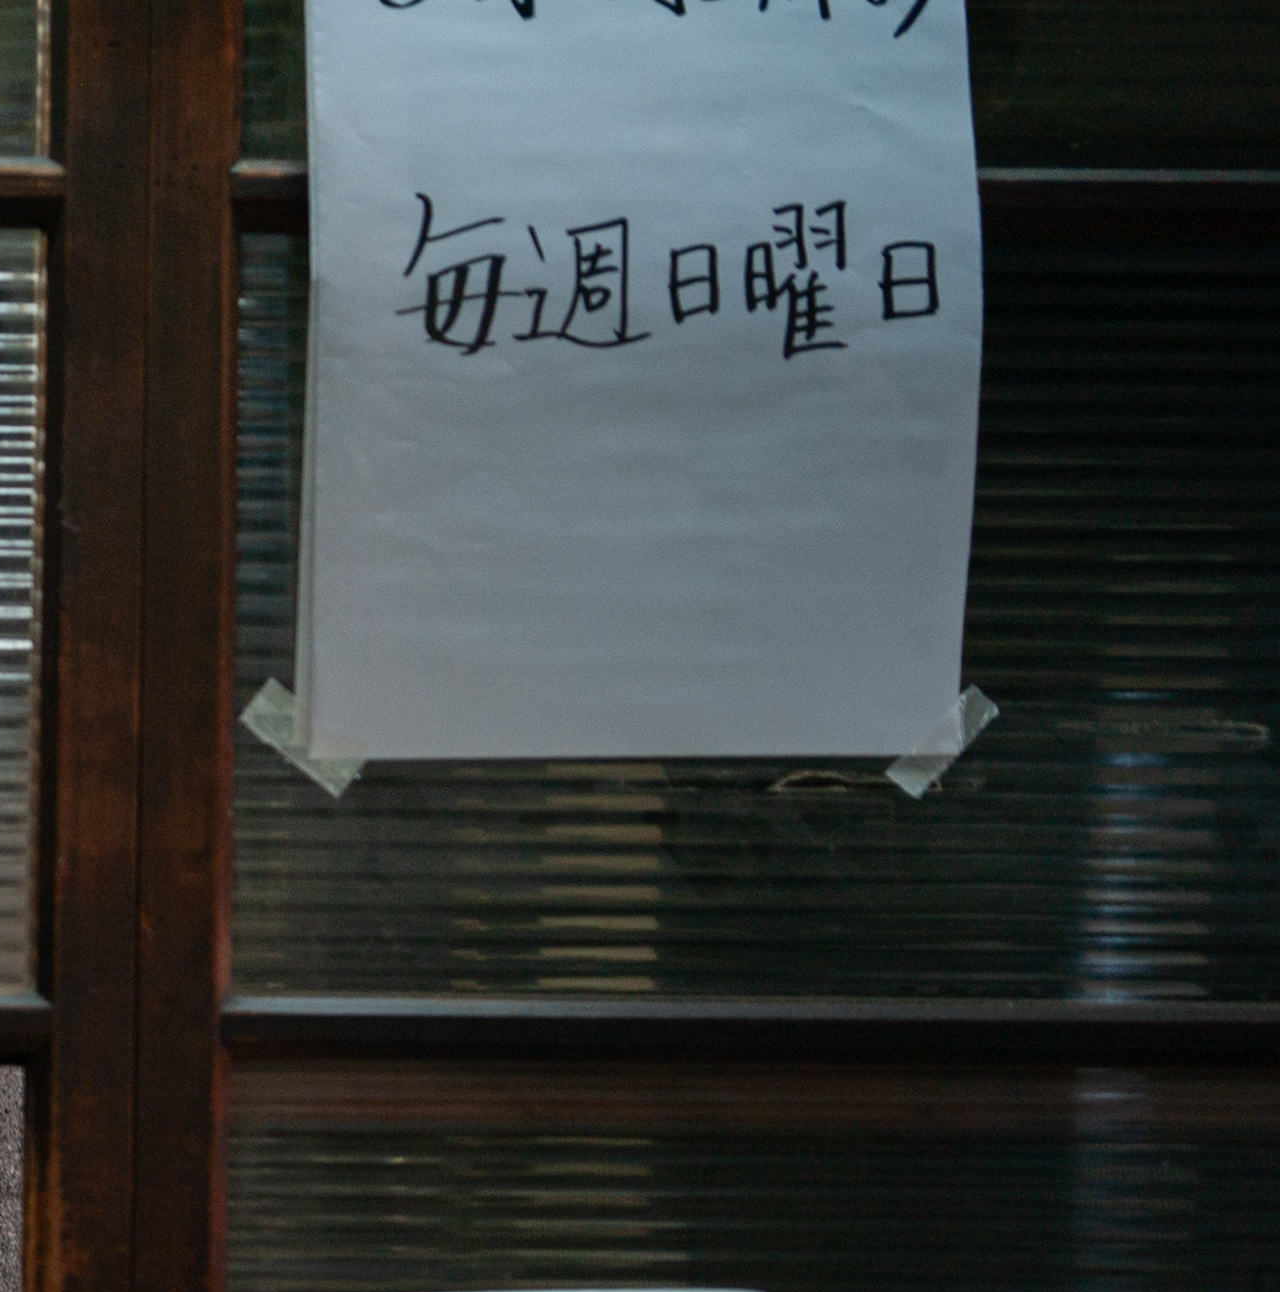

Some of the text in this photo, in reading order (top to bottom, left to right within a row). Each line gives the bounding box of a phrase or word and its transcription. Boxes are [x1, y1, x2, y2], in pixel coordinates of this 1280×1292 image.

[395, 192, 940, 361] 毎週日曜日
